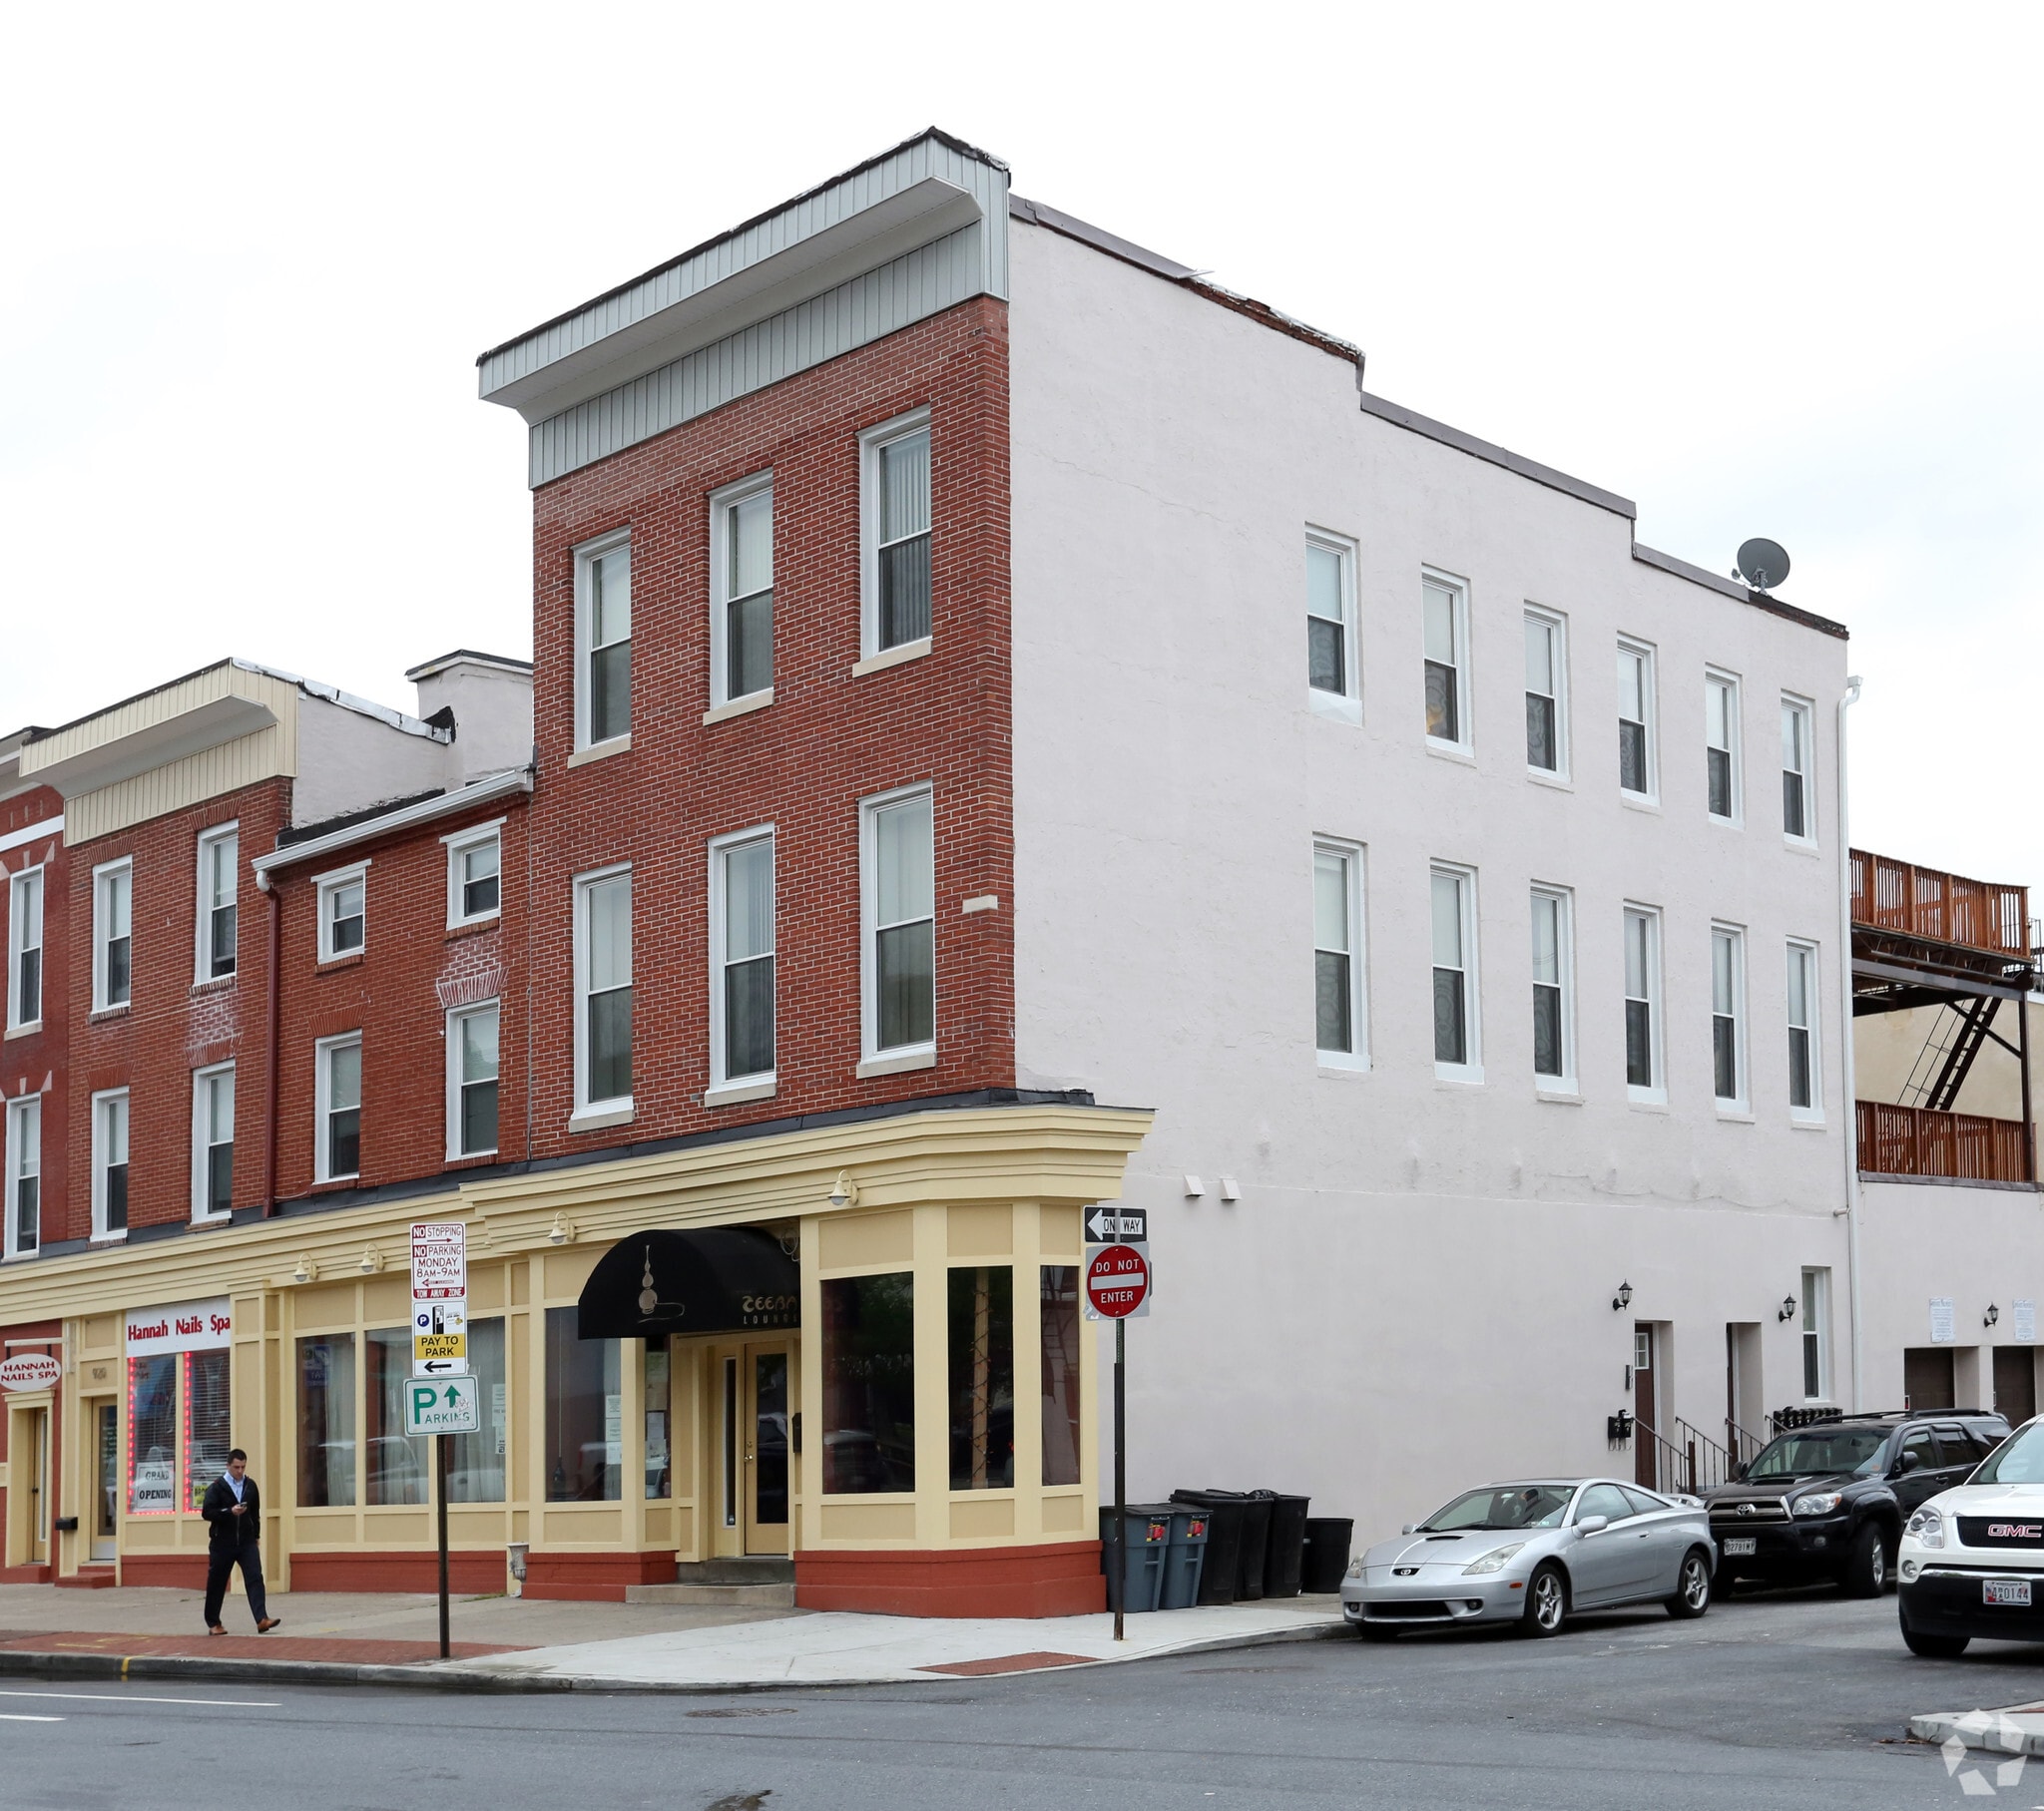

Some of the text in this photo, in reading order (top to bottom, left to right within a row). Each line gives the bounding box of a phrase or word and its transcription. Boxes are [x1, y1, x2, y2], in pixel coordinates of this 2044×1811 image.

[1104, 1218, 1140, 1232] ON WAY
[413, 1226, 461, 1238] NO STOPPING
[414, 1245, 461, 1257] NO PARKING
[418, 1257, 458, 1268] MONDAY
[1096, 1258, 1139, 1273] DO NOT
[416, 1287, 462, 1298] TOW AWAY ZONE
[1101, 1290, 1134, 1304] ENTER
[128, 1314, 231, 1341] Hannah Nails Spa
[421, 1335, 459, 1346] PAY TO
[425, 1347, 454, 1357] PARK
[4, 1361, 55, 1373] HANNAH
[0, 1370, 58, 1382] NAILS SPA
[145, 1470, 170, 1481] GRAND
[139, 1489, 172, 1500] OPENING
[1988, 1524, 2043, 1538] GMC
